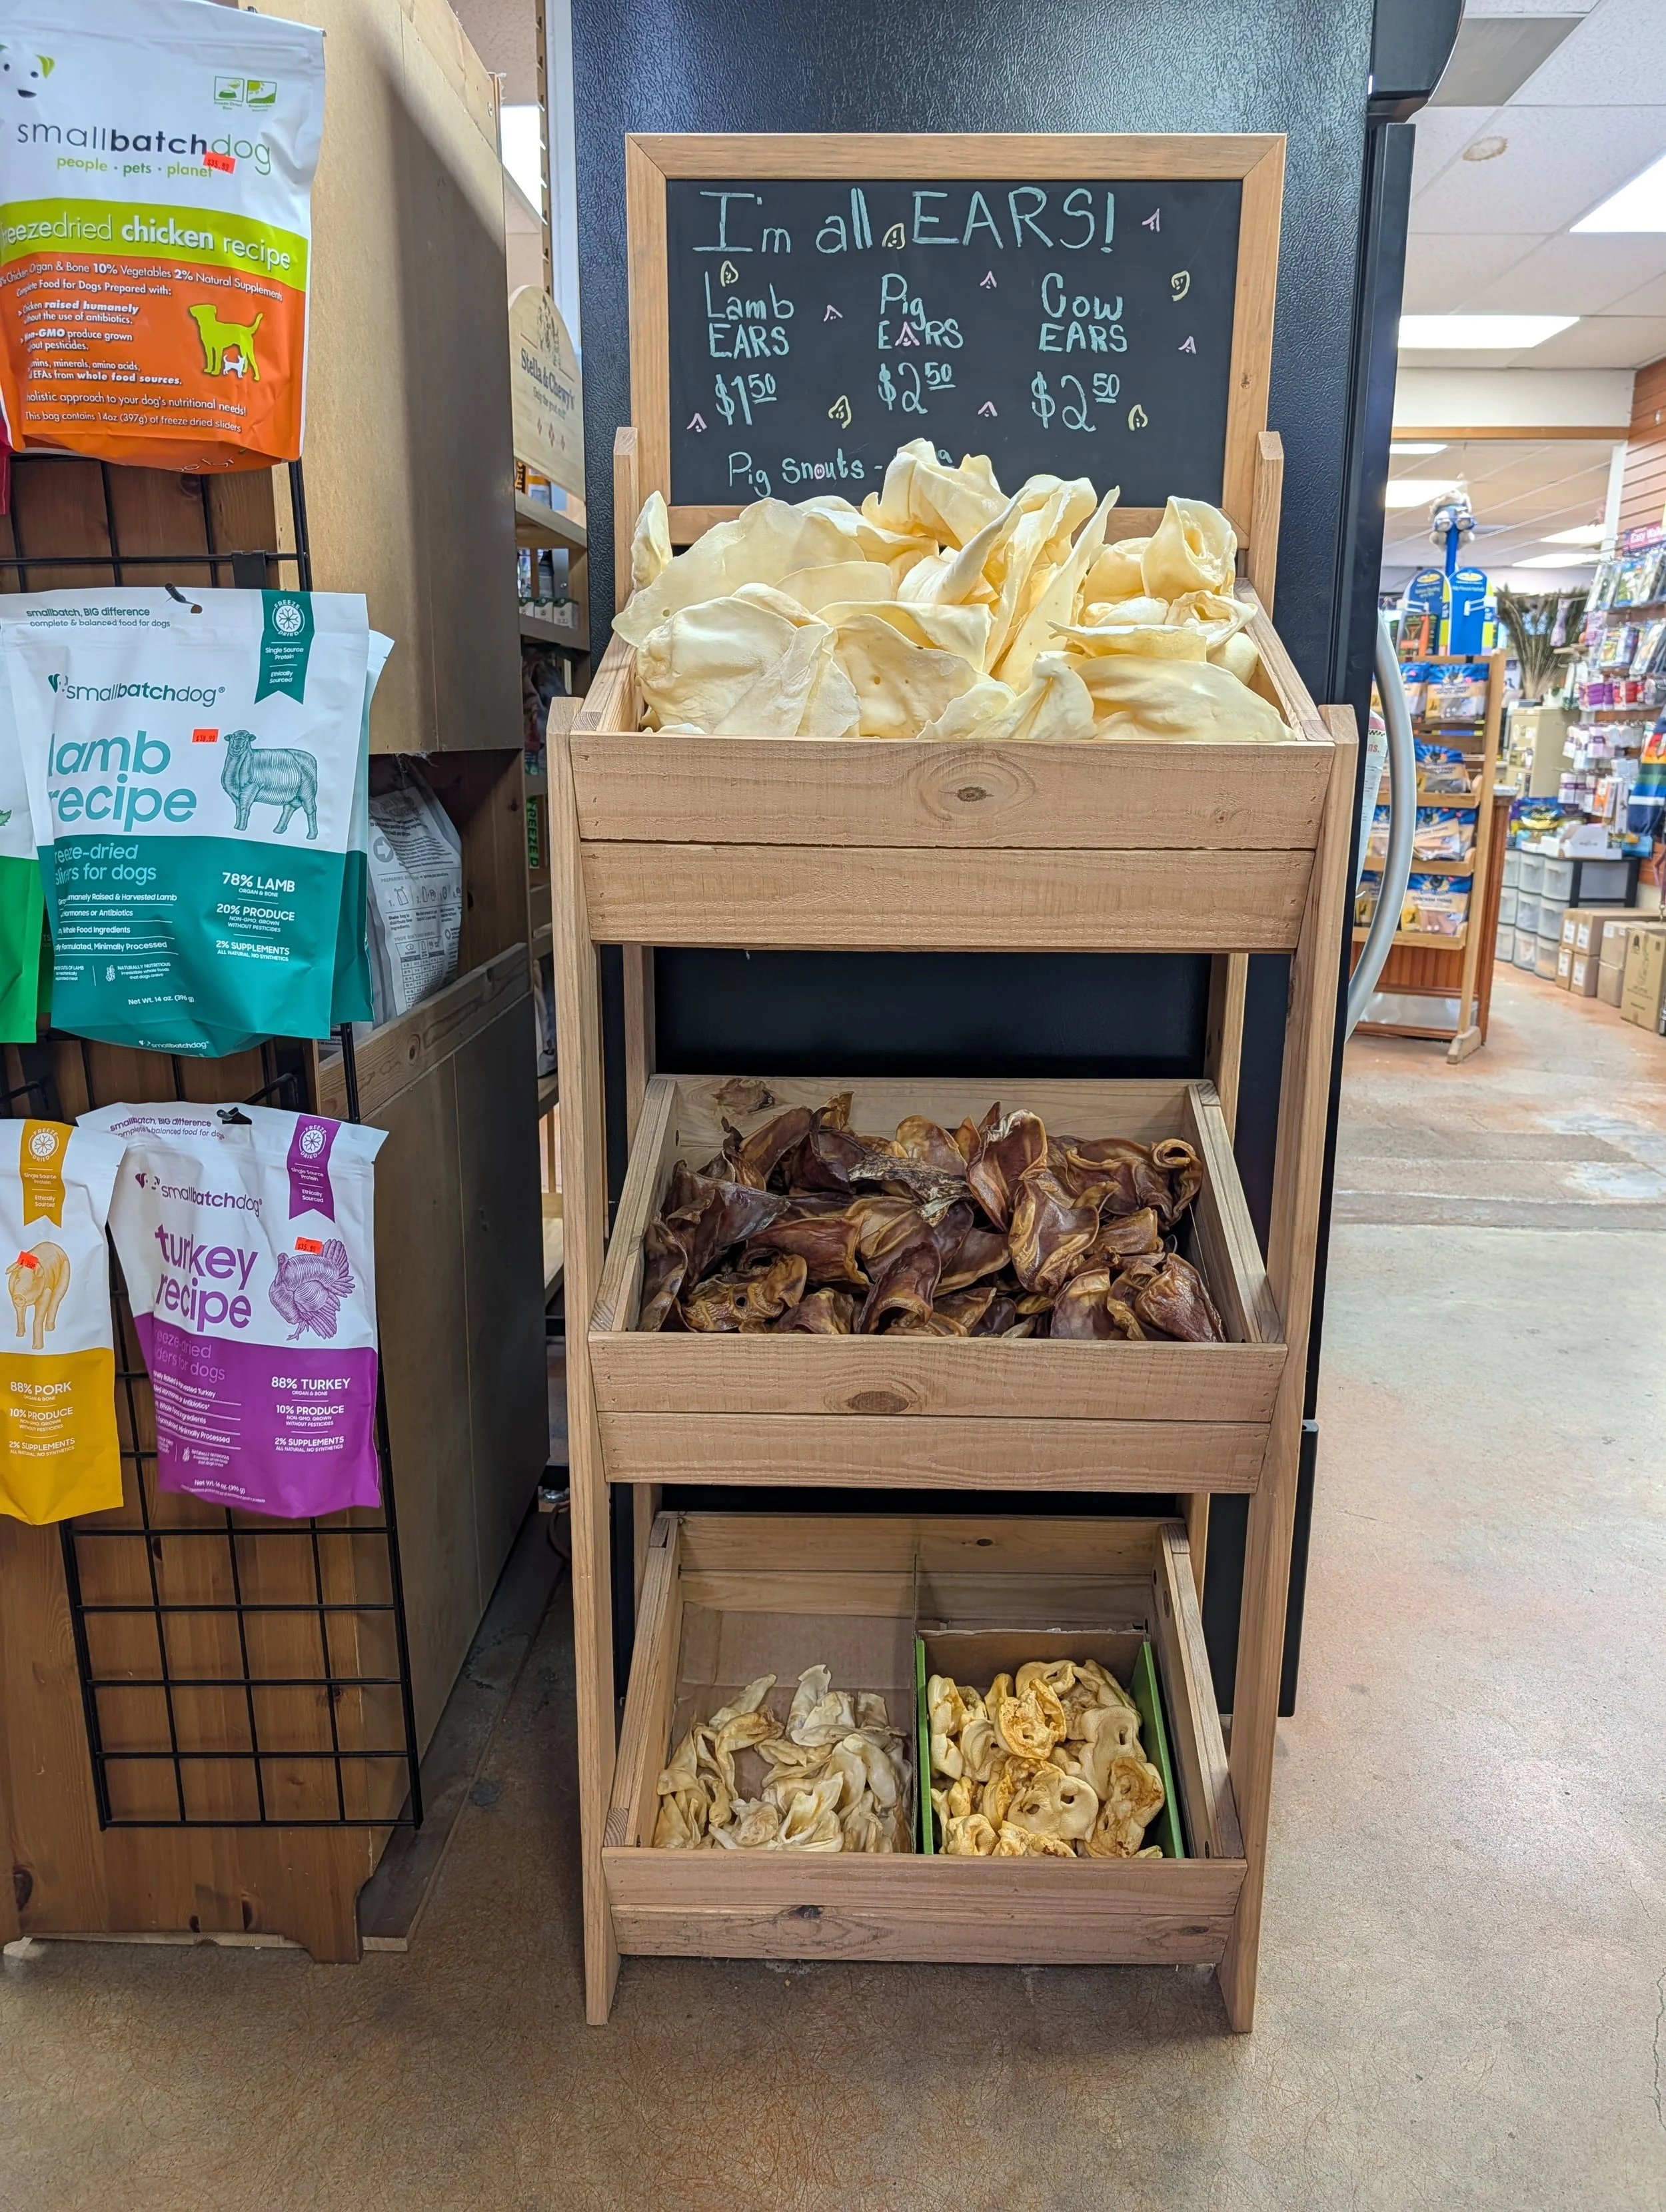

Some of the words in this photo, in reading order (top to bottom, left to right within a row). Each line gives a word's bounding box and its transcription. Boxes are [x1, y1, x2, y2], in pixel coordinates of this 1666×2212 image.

[17, 123, 272, 175] smallbatchdog
[57, 155, 108, 172] people
[123, 162, 152, 177] pets
[167, 162, 213, 179] planet
[691, 189, 791, 255] I'm
[815, 187, 875, 255] all
[910, 185, 1114, 254] EARS!
[1, 211, 112, 245] reezedried
[121, 215, 215, 251] chicken
[223, 238, 291, 270] recipe
[30, 262, 53, 275] Organ
[56, 262, 64, 272] &
[66, 262, 89, 273] Bone
[93, 263, 118, 275] 10%
[120, 265, 171, 278] Vegetables
[174, 269, 193, 280] 2%
[196, 272, 231, 286] Natural
[234, 277, 283, 301] Supplements
[39, 278, 60, 289] Food
[63, 278, 76, 288] for
[79, 280, 101, 292] Dogs
[104, 282, 145, 294] Prepared
[149, 284, 171, 295] with:
[704, 269, 795, 322] Lamb
[878, 271, 926, 332] Pig
[1039, 271, 1124, 321] Cow
[45, 299, 79, 310] raised
[83, 300, 139, 315] humanely
[43, 310, 56, 320] the
[59, 312, 73, 321] use
[75, 312, 85, 321] of
[86, 312, 133, 324] antibiotics.
[67, 328, 102, 340] produce
[104, 332, 133, 342] grown
[708, 321, 790, 360] EARS
[876, 318, 964, 351] EARS
[1036, 322, 1129, 354] EARS
[45, 340, 89, 352] pesticides.
[53, 358, 91, 370] minerals,
[92, 360, 116, 370] amino
[118, 360, 141, 372] acids,
[33, 370, 53, 379] EFAs
[54, 370, 75, 380] from
[77, 371, 107, 381] whole
[111, 372, 136, 382] food
[139, 376, 183, 385] sources.
[59, 392, 105, 405] approach
[107, 394, 117, 403] to
[119, 395, 139, 406] your
[141, 394, 167, 408] dog's
[169, 396, 216, 410] nutritional
[219, 402, 247, 416] needs!
[25, 411, 41, 420] This
[42, 411, 59, 422] bag
[61, 412, 95, 421] contains
[98, 412, 118, 422] 14oz
[120, 412, 147, 426] (397g)
[149, 415, 159, 424] of
[161, 415, 188, 426] freeze
[189, 417, 213, 427] dried
[215, 420, 242, 433] sliders
[726, 449, 772, 498] Pig
[26, 608, 83, 618] smallbatch,
[83, 607, 99, 617] BIG
[101, 606, 151, 617] difference
[274, 599, 301, 610] FREEZE
[30, 619, 69, 628] complete
[151, 619, 171, 629] dogs
[48, 730, 172, 778] lamb
[55, 841, 139, 864] reeze-dried
[83, 862, 107, 881] for
[111, 863, 157, 886] dogs
[222, 871, 254, 888] 78%
[257, 876, 296, 893] LAMB
[92, 892, 114, 901] Raised
[121, 893, 156, 901] Harvested
[239, 887, 259, 896] ORGAN
[216, 903, 241, 915] 20%
[243, 906, 296, 921] PRODUCE
[93, 925, 131, 935] Ingredients
[227, 921, 252, 930] WITHOUT
[253, 924, 281, 933] PESTICIDES
[94, 943, 125, 952] Minimally
[126, 941, 168, 950] Processed
[215, 939, 230, 949] 2%
[231, 941, 291, 955] SUPPLEMENTS
[172, 1116, 212, 1127] difference
[151, 1126, 182, 1135] balanced
[182, 1127, 197, 1136] food
[199, 1128, 209, 1137] for
[300, 1150, 319, 1159] DRIED
[302, 1195, 325, 1203] Sourced
[154, 1224, 259, 1291] turkey
[155, 1273, 252, 1333] recipe
[190, 1362, 226, 1384] dogs
[10, 1381, 33, 1394] 88%
[35, 1381, 72, 1396] PORK
[271, 1376, 298, 1390] 88%
[301, 1377, 351, 1390] TURKEY
[9, 1407, 27, 1418] 10%
[27, 1406, 73, 1420] PRODUCE
[276, 1404, 294, 1414] 10%
[296, 1404, 345, 1416] PRODUCE
[9, 1440, 21, 1449] 2%
[21, 1437, 75, 1451] SUPPLEMENTS
[275, 1437, 287, 1446] 2%
[288, 1436, 345, 1446] SUPPLEMENTS
